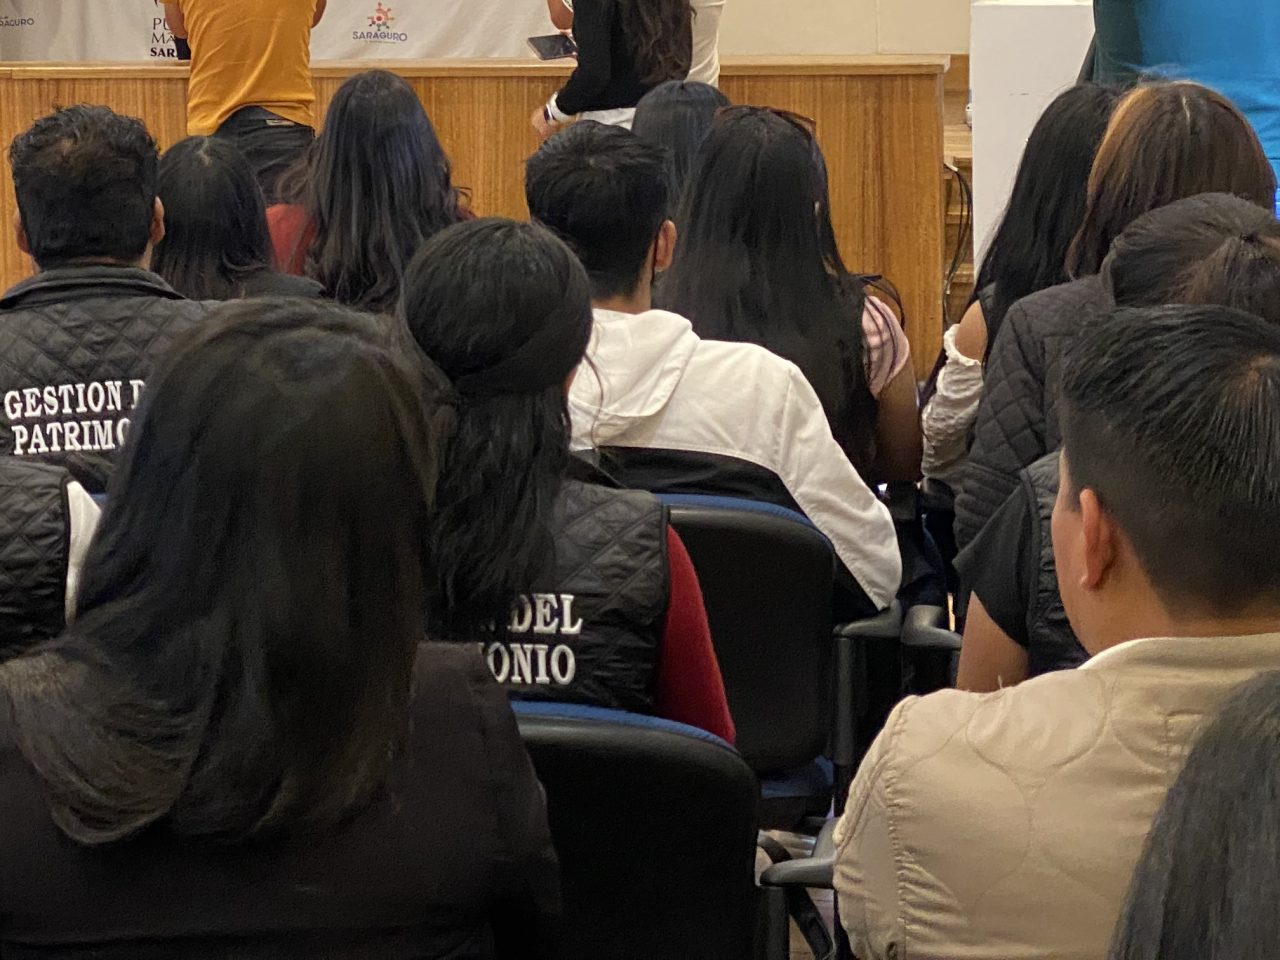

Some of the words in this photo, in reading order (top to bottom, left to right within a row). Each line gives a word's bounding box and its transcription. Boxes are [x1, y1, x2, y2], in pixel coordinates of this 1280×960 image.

[352, 30, 408, 42] SARAGURO
[4, 380, 123, 420] GESTION
[10, 417, 131, 456] PATRIMO
[507, 593, 584, 635] DEL
